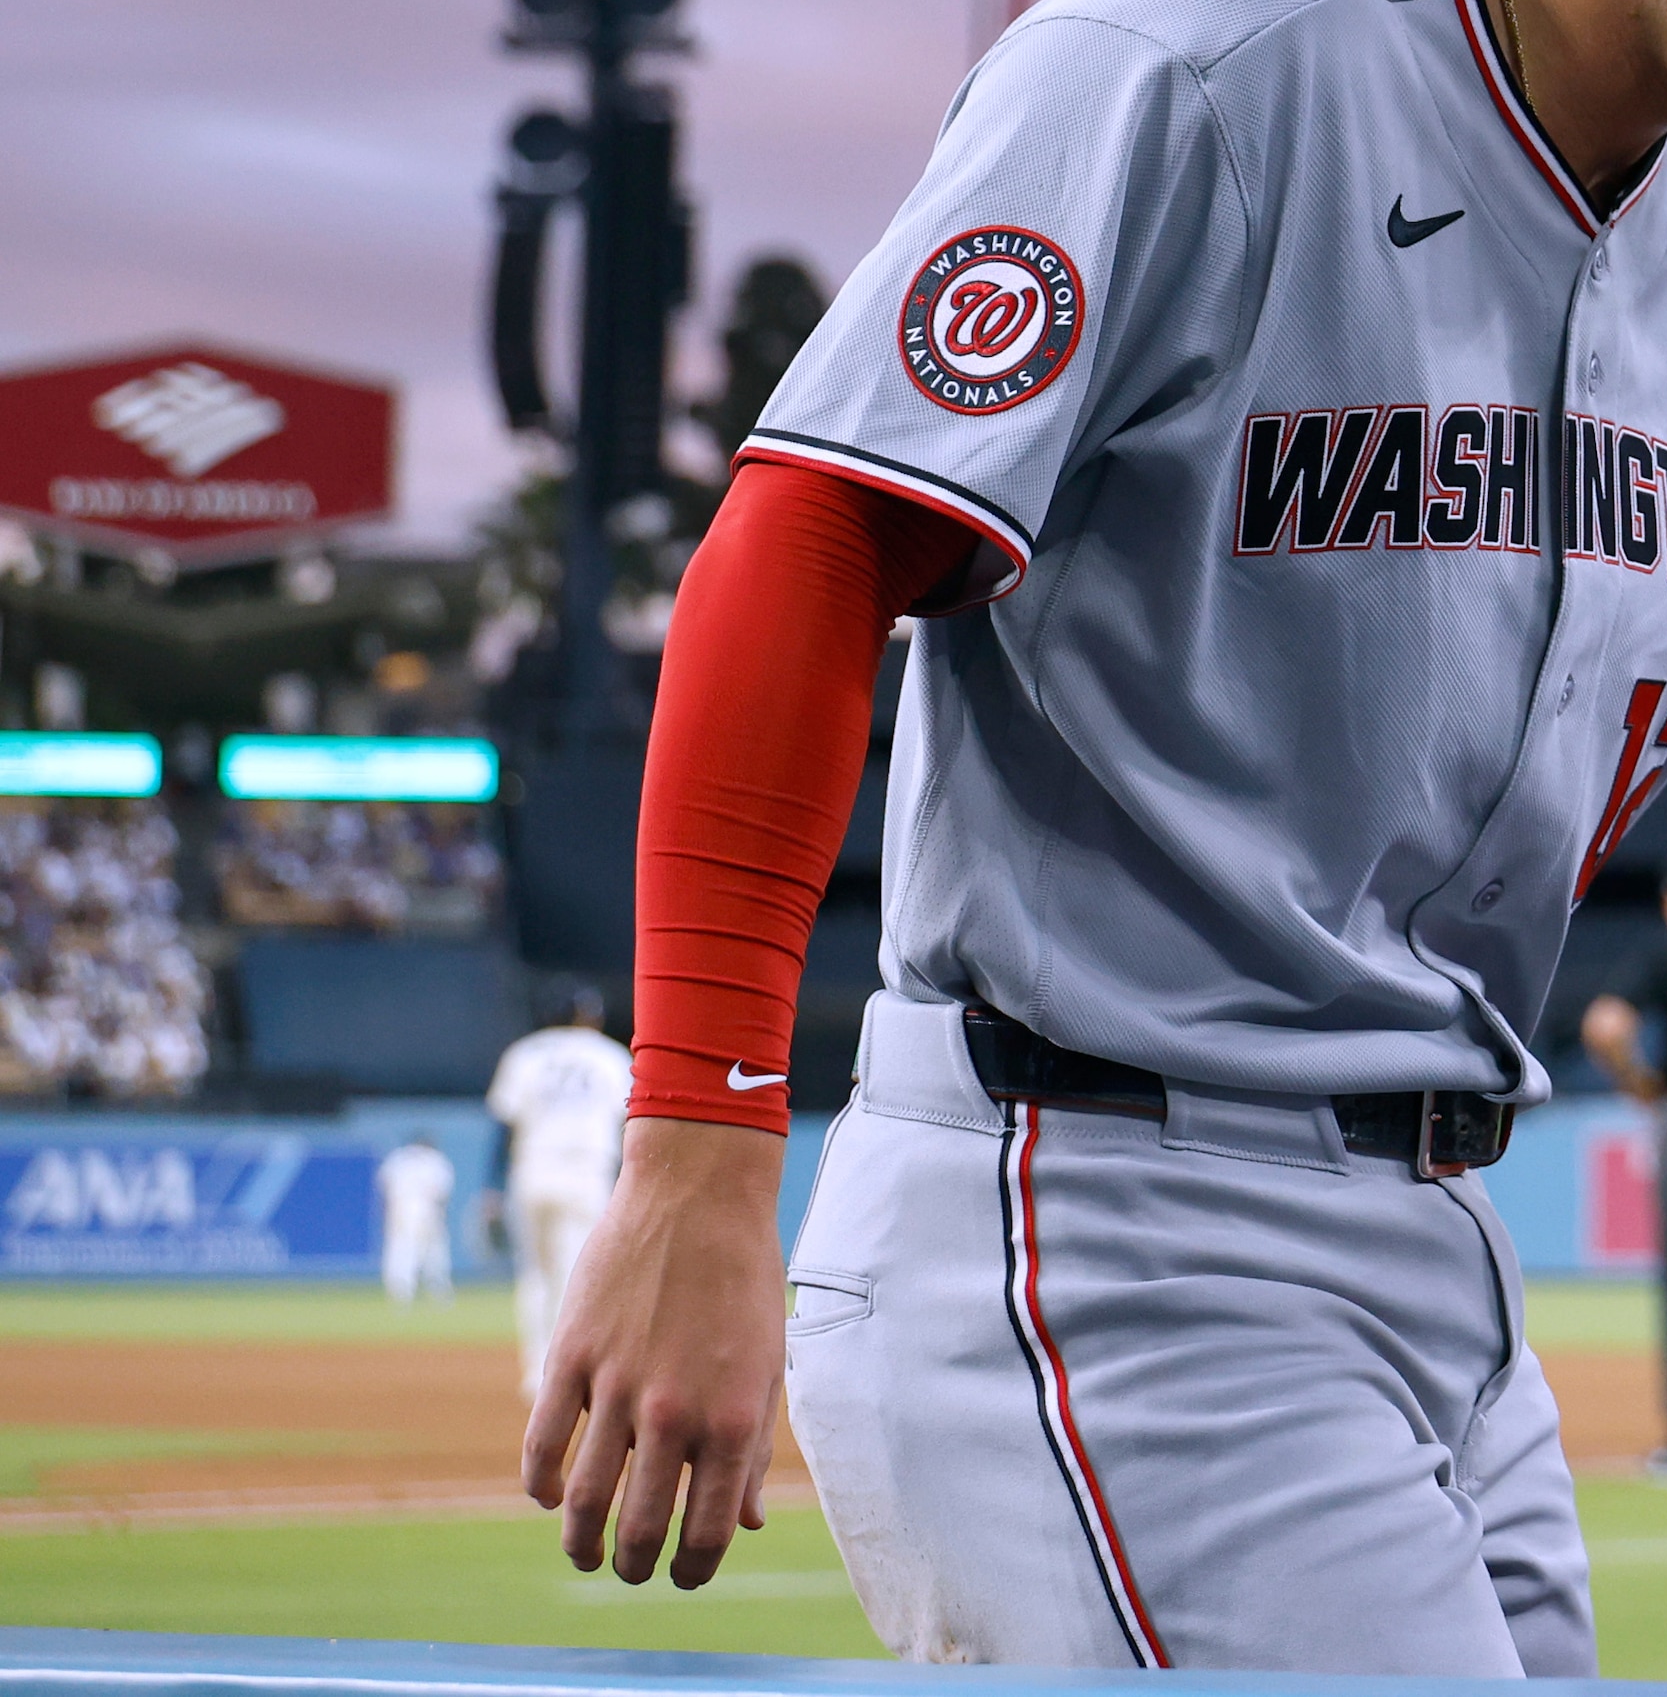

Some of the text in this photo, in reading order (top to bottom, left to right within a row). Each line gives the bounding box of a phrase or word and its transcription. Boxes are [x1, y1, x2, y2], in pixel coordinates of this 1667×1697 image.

[930, 234, 1074, 327] WASHINGTON
[905, 325, 1034, 406] NATIONALS
[6, 1149, 198, 1228] ANA
